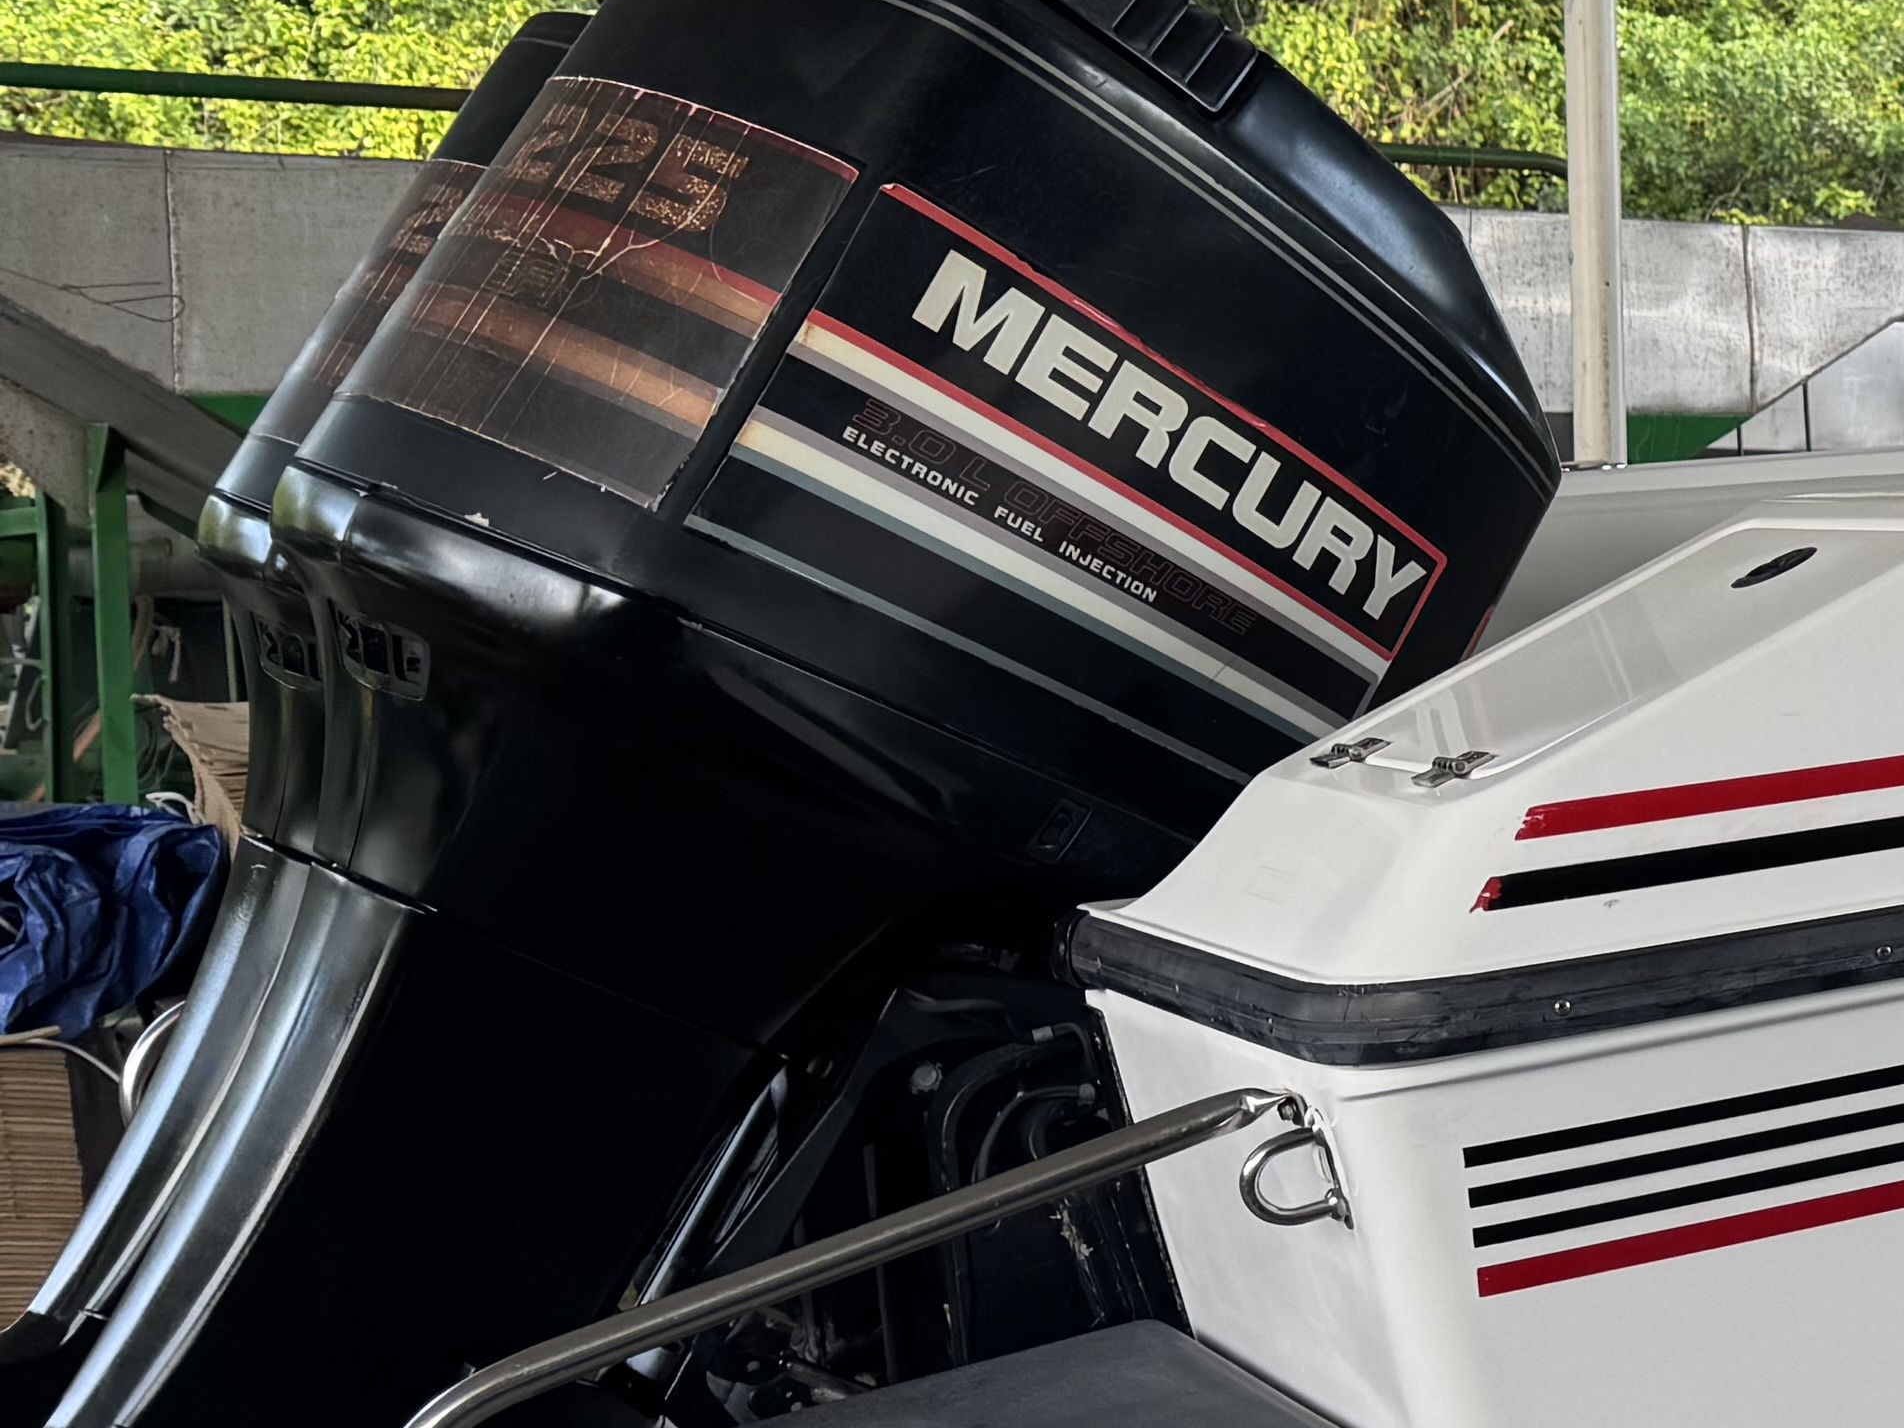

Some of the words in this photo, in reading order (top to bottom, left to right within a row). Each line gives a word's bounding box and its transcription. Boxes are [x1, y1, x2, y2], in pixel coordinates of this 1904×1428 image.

[503, 102, 750, 232] 225
[842, 426, 980, 506] ELECTRONIC
[993, 505, 1045, 543] FUEL
[1059, 540, 1158, 603] INJECTION
[852, 398, 957, 466] 3.0
[1003, 481, 1258, 635] OFFSHORE
[911, 249, 1427, 621] MERCURY
